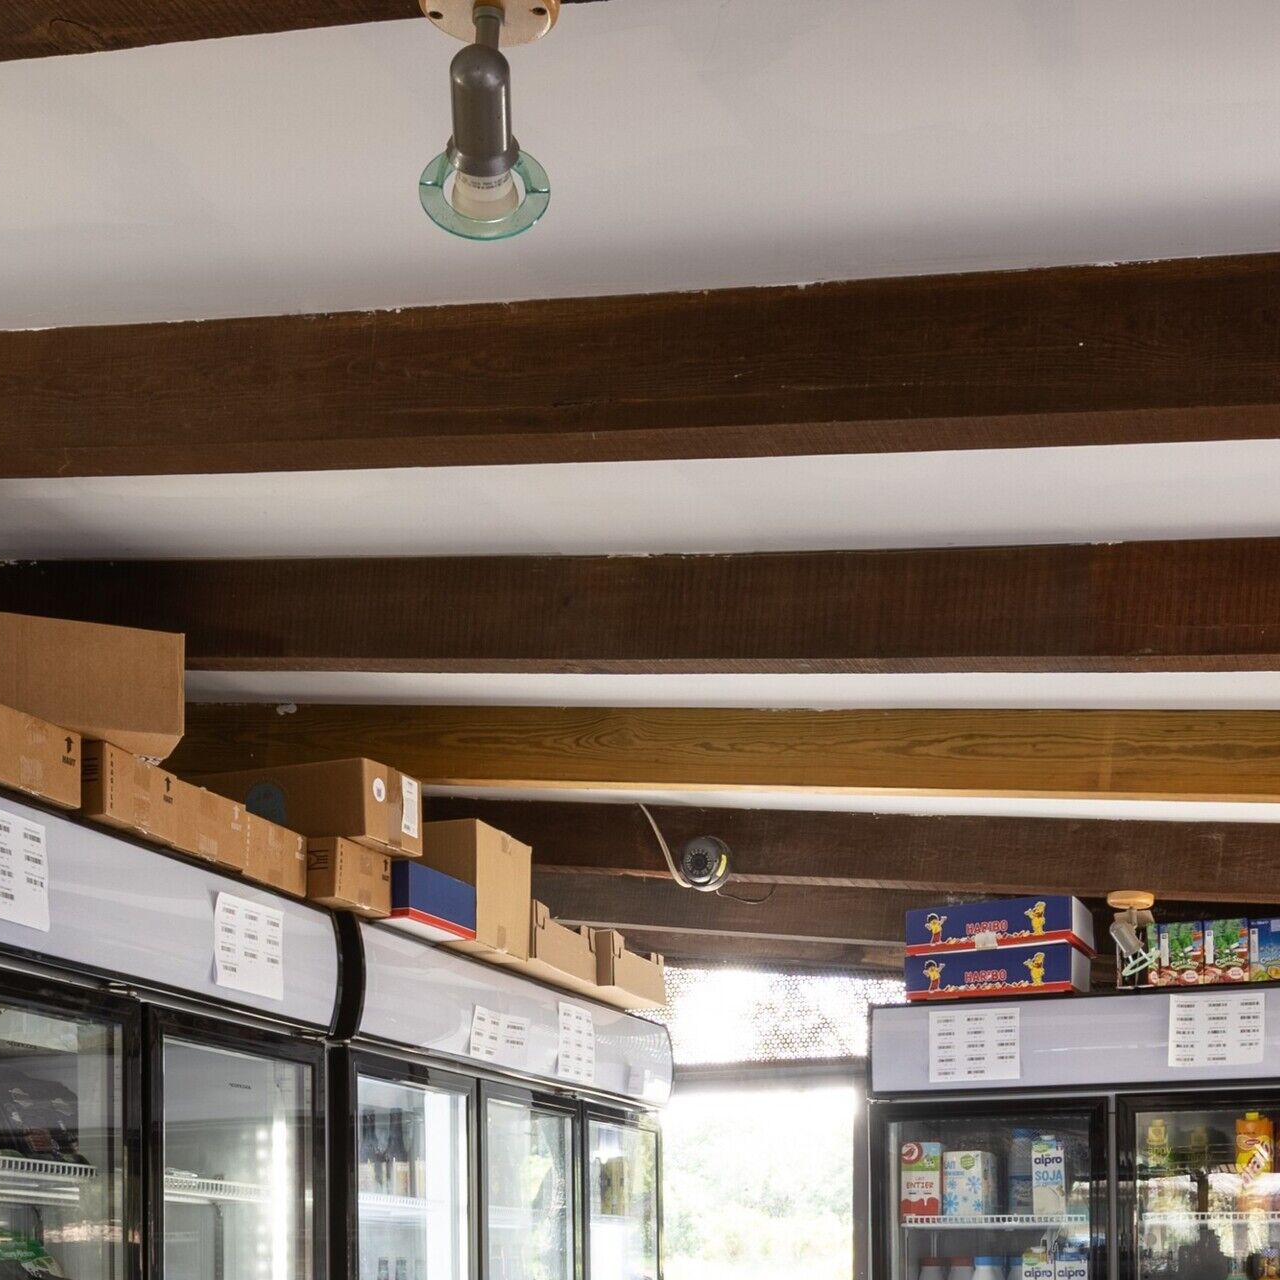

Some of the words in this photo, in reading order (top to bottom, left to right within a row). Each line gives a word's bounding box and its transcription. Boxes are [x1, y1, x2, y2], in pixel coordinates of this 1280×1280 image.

[965, 919, 1009, 935] HARIBO
[1033, 1155, 1063, 1167] alpro
[1034, 1170, 1063, 1182] SOJA
[1024, 1268, 1053, 1280] alpro
[1057, 1268, 1086, 1280] alpro
